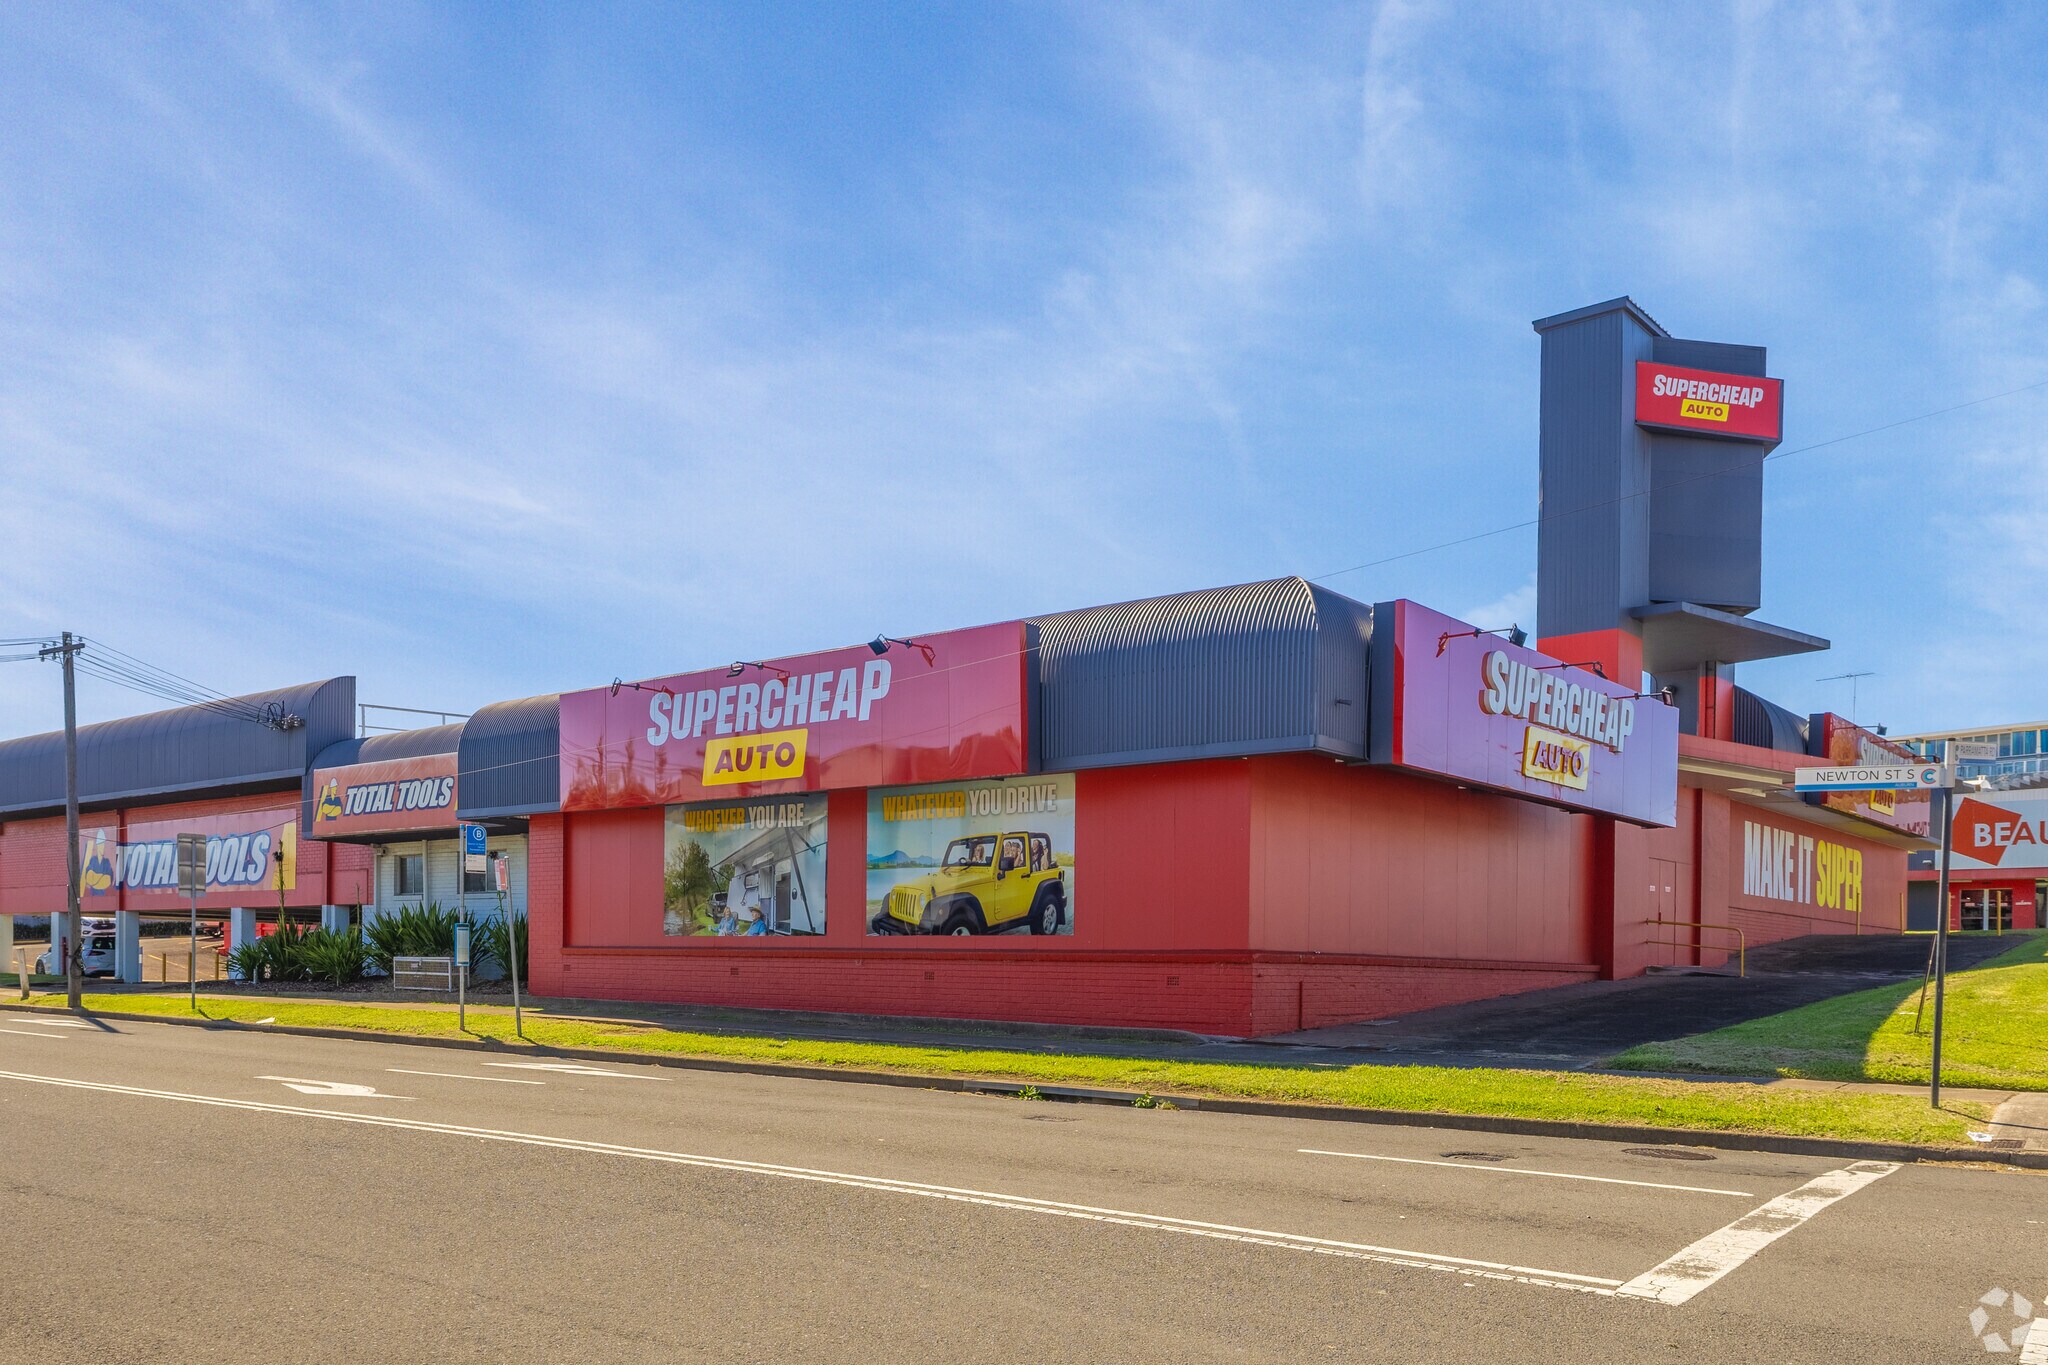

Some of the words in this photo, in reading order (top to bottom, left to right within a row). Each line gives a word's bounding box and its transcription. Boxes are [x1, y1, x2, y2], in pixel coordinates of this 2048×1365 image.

[1652, 374, 1764, 409] SUPERCHEAP
[1686, 403, 1723, 417] AUTO
[646, 659, 892, 746] SUPERCHEAP
[1480, 650, 1635, 754] SUPERCHEAP
[713, 741, 796, 774] AUTO
[1533, 740, 1585, 777] AUTO
[1816, 770, 1879, 782] NEWTON
[1885, 769, 1901, 780] ST
[1907, 769, 1915, 779] S
[344, 782, 395, 816] TOTAL
[396, 777, 455, 812] TOOLS
[883, 791, 966, 822] WHATEVER
[969, 788, 1001, 816] YOU
[1005, 784, 1057, 814] DRIVE
[685, 807, 746, 833] WHOEVER
[748, 805, 775, 830] YOU
[777, 802, 805, 828] ARE
[115, 842, 179, 887] TOTA
[205, 833, 271, 883] OOLS
[1743, 820, 1795, 902] MAKE
[1798, 834, 1814, 905] IT
[1816, 839, 1863, 913] SUPER
